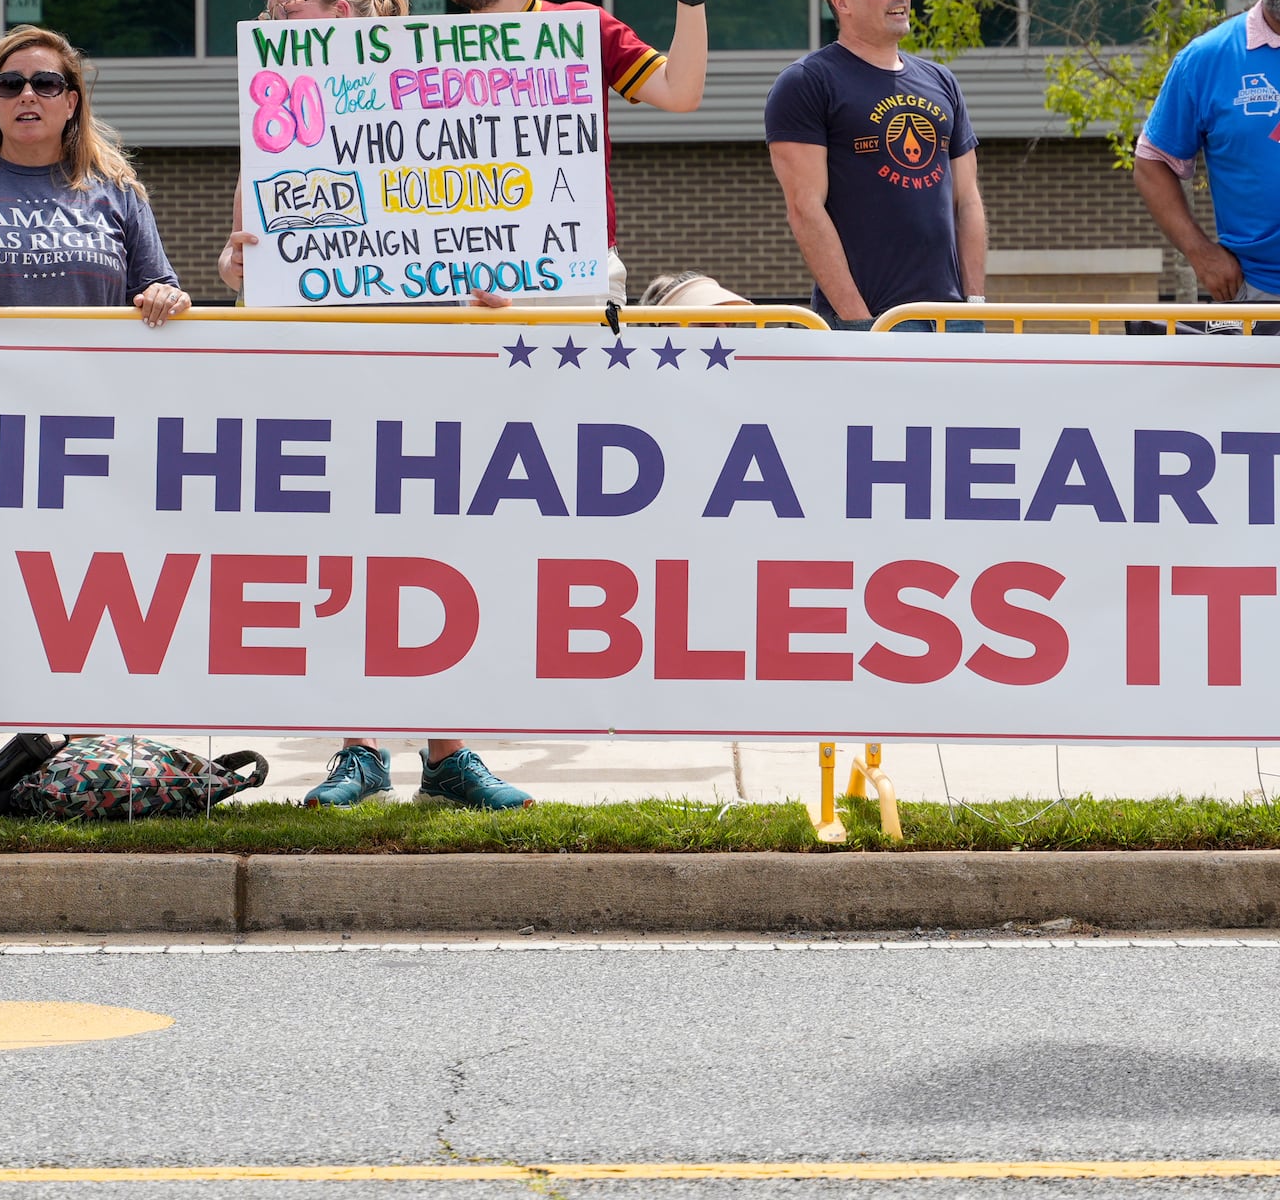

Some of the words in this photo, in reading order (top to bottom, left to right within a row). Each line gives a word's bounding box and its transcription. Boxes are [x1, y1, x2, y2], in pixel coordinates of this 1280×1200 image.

[253, 26, 335, 68] WHY
[355, 24, 391, 65] IS
[405, 22, 525, 64] THERE
[534, 21, 585, 62] AN
[324, 71, 376, 99] Year
[335, 89, 386, 116] old
[389, 64, 593, 111] PEDOPHILE
[249, 70, 326, 153] 80
[869, 94, 948, 125] RHINEGEIST
[330, 120, 404, 165] WHO
[416, 113, 501, 162] CAN'T
[516, 113, 598, 157] EVEN
[854, 140, 880, 150] CINCY
[273, 180, 355, 213] READ
[382, 167, 526, 211] HOLDING
[551, 167, 575, 203] A
[877, 163, 945, 190] BREWERY
[22, 251, 120, 271] EVERYTHING
[30, 232, 127, 256] RIGHT
[277, 229, 420, 263] CAMPAIGN
[434, 224, 520, 254] EVENT
[542, 222, 581, 253] AT
[298, 262, 394, 301] OUR
[400, 257, 562, 298] SCHOOLS
[569, 259, 598, 278] ???
[156, 417, 331, 513] HE
[375, 421, 665, 516] HAD
[703, 424, 804, 518] A
[16, 551, 479, 677] WE'D
[536, 559, 1069, 685] BLESS
[1127, 565, 1276, 686] IT
